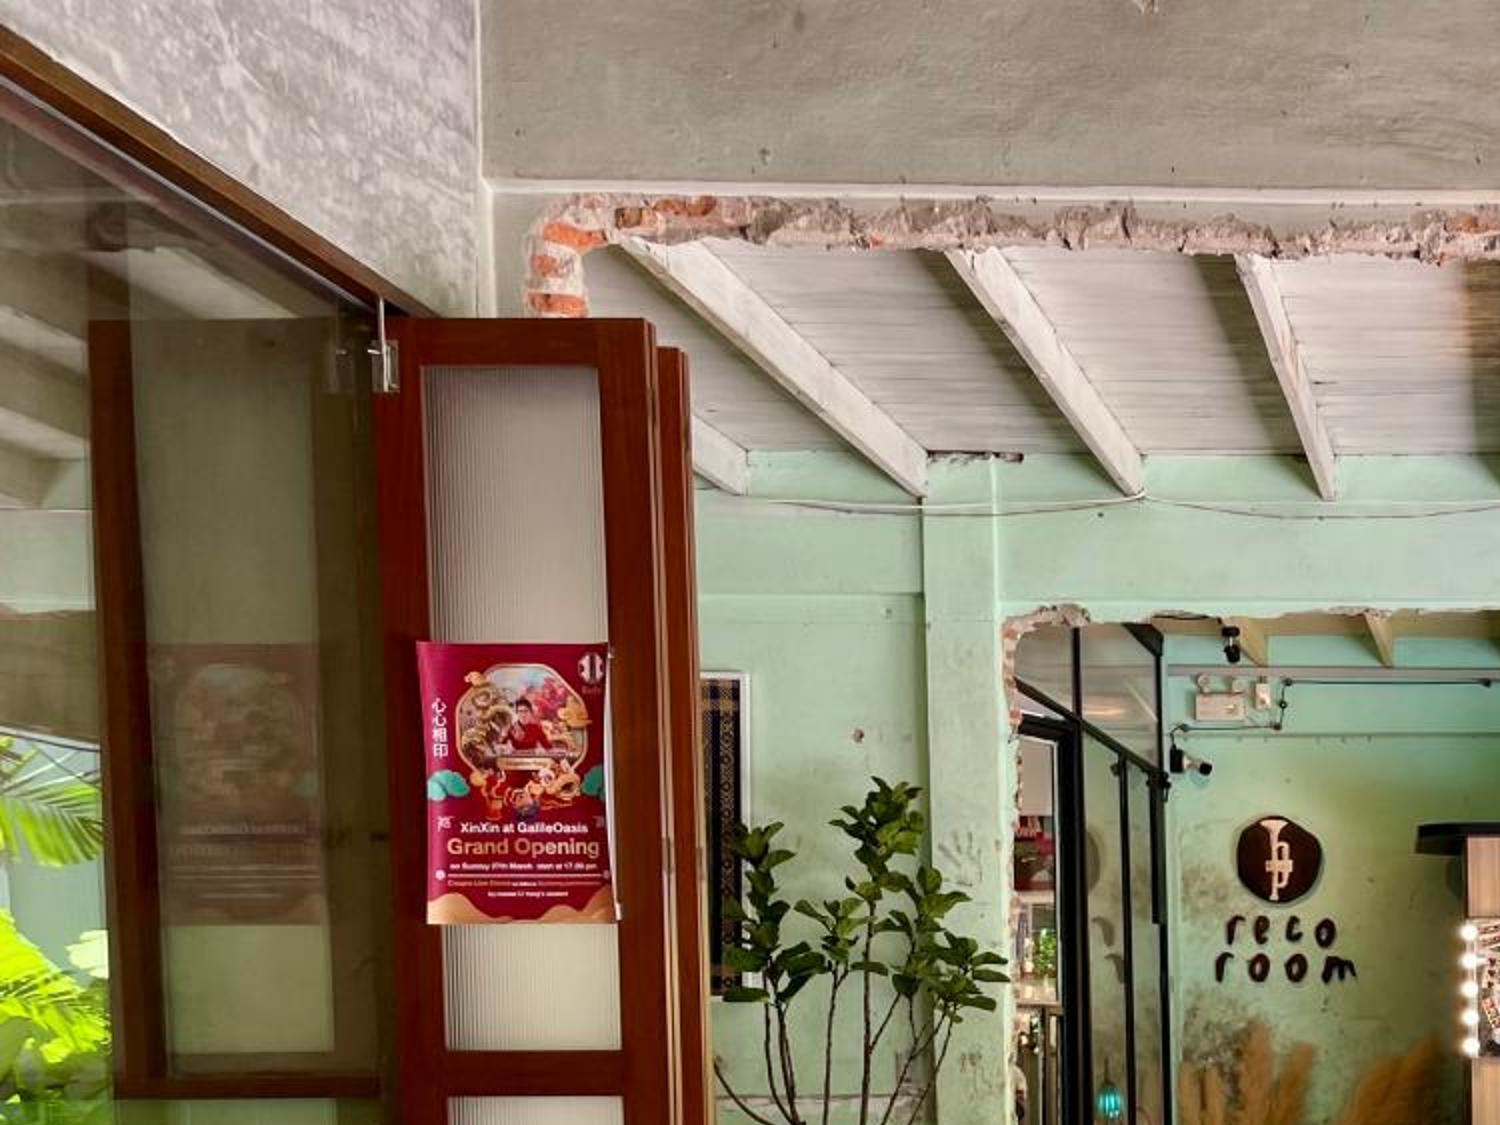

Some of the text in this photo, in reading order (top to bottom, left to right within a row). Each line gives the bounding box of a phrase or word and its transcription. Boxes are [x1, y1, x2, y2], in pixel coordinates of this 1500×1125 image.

[460, 822, 500, 833] XinXin
[502, 822, 514, 833] at
[447, 837, 600, 859] Grand Opening
[1226, 914, 1337, 948] reco
[1215, 951, 1358, 984] room
